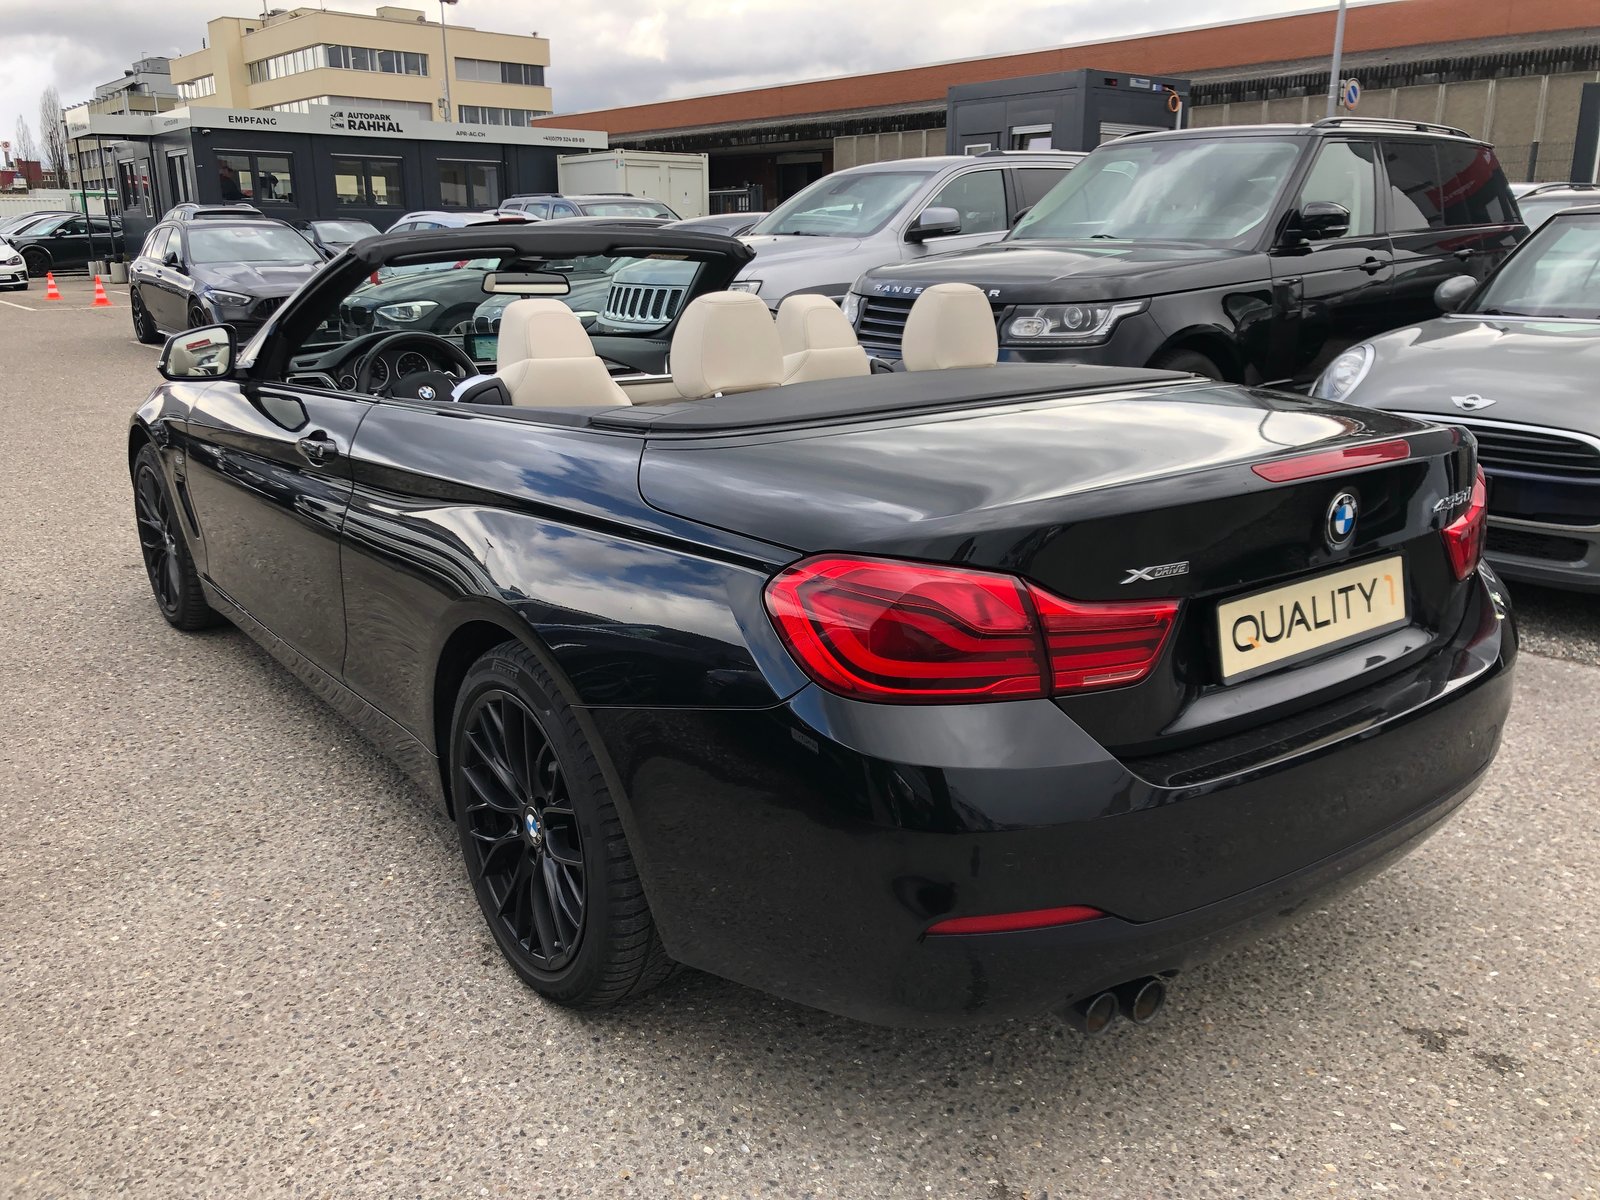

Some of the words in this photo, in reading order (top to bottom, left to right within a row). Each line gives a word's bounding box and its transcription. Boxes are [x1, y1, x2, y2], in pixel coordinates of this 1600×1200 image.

[228, 115, 277, 126] EMPFANG
[347, 112, 391, 121] AUTOPARK
[347, 119, 404, 133] RAHHAL
[873, 284, 923, 294] RANGE
[1232, 577, 1378, 653] QUALITY
[1383, 574, 1396, 606] 1
